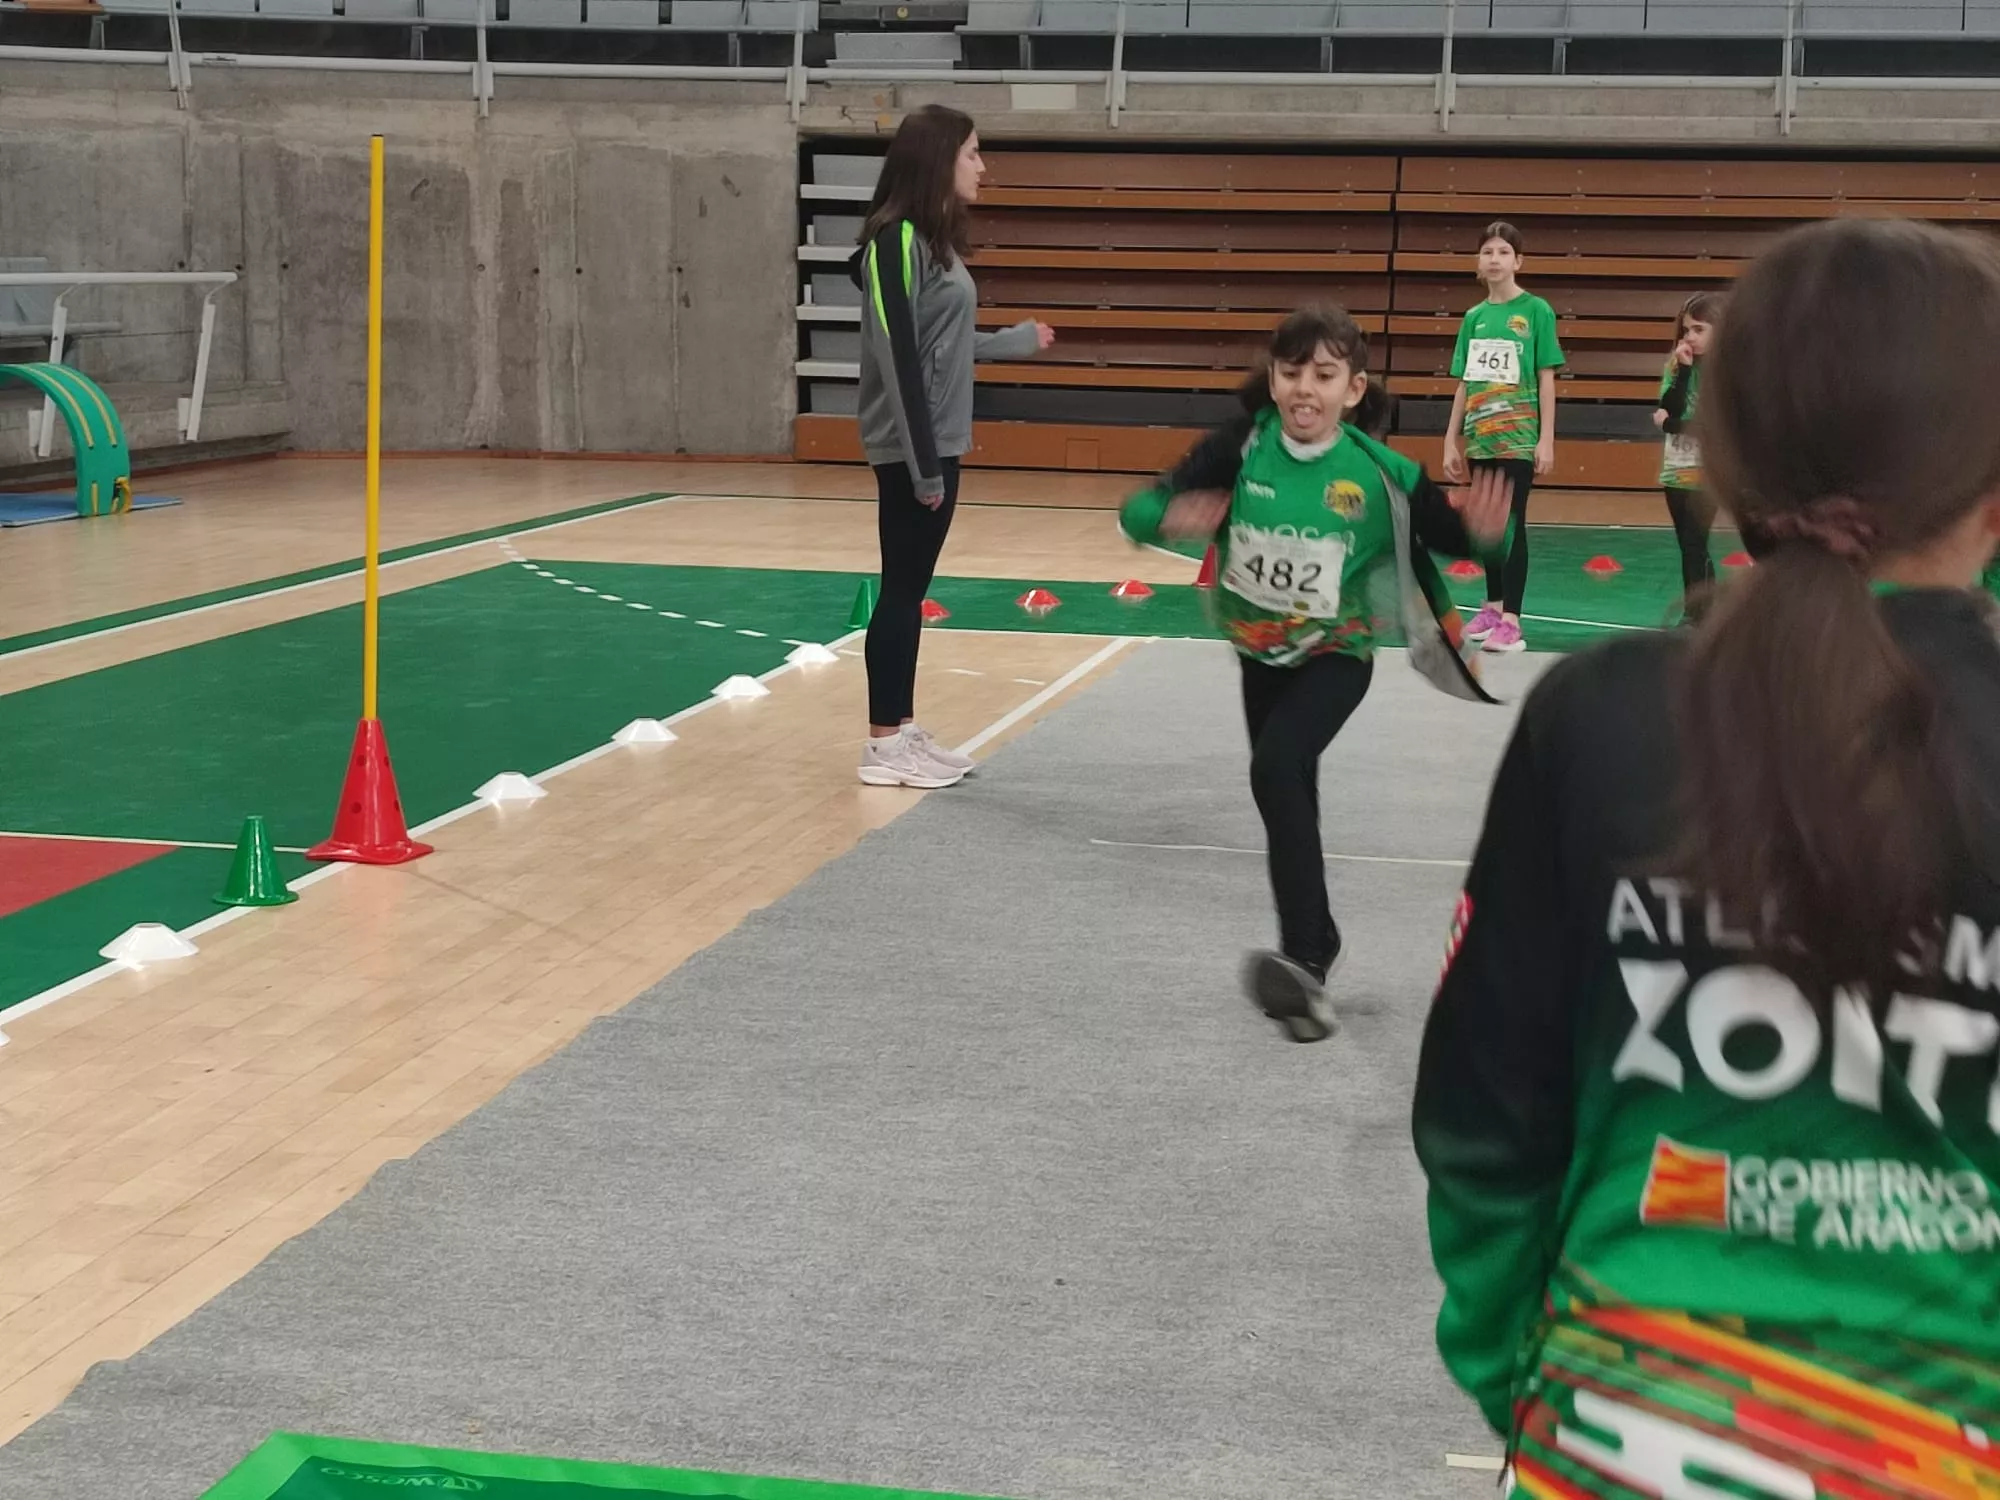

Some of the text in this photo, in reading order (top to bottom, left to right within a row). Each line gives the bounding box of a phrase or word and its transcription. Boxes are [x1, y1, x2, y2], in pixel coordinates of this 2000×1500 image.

[1477, 351, 1510, 370] 461
[1243, 553, 1322, 594] 482
[1732, 1154, 1990, 1209] GOBIERNO
[1732, 1198, 1798, 1245] DE
